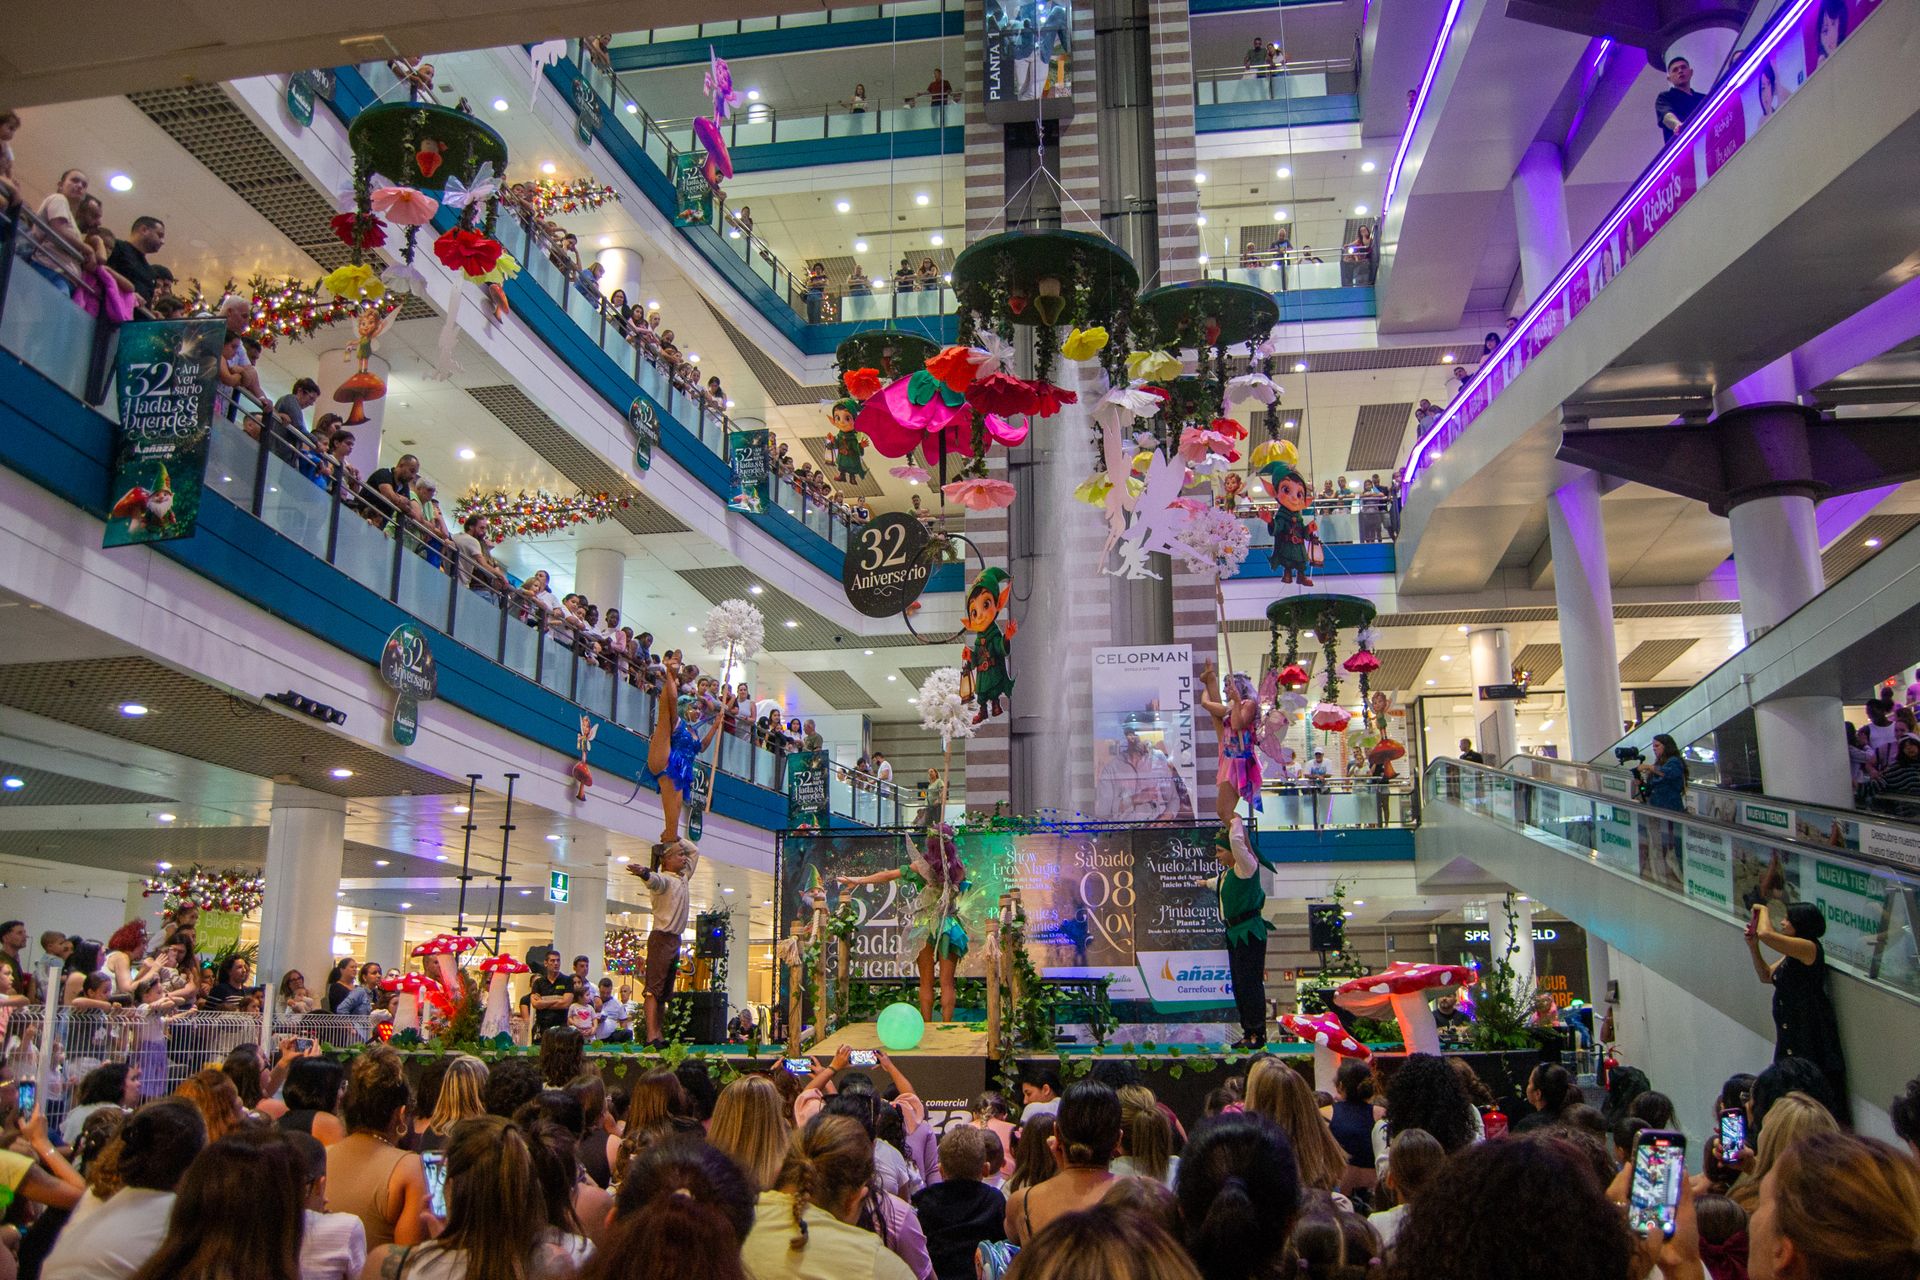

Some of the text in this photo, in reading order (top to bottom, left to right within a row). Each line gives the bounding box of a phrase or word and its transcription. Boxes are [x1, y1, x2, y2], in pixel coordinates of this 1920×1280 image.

[990, 44, 1000, 100] PLANTA
[1641, 172, 1681, 232] Ricky's
[125, 361, 173, 397] 32
[174, 384, 203, 396] sario
[735, 447, 753, 462] 32
[861, 523, 907, 570] 32
[851, 564, 927, 591] Aniversario
[402, 630, 424, 673] 32
[1095, 651, 1189, 665] CELOPMAN
[1178, 676, 1195, 769] PLANTA 1
[794, 770, 812, 787] 32
[1747, 806, 1787, 826] NUEVA TIENDA
[1871, 829, 1898, 844] Descubre
[1004, 843, 1037, 863] Show
[1074, 841, 1135, 869] Sábado
[1170, 838, 1205, 859] Show
[1868, 845, 1916, 863] nueva tienda con
[1147, 858, 1184, 873] Vuelo
[1192, 859, 1226, 876] Hada
[1819, 865, 1849, 887] NUEVA
[1188, 874, 1203, 882] Agua
[1080, 870, 1136, 908] 08
[206, 911, 230, 929] Bike
[1176, 919, 1200, 927] Planta
[1828, 905, 1881, 935] DEICHMAN
[1075, 908, 1137, 953] Nov
[1464, 930, 1556, 941] SPRELD
[1177, 985, 1217, 994] Carrefour
[1552, 992, 1574, 1008] ORE
[925, 1098, 969, 1107] comercial
